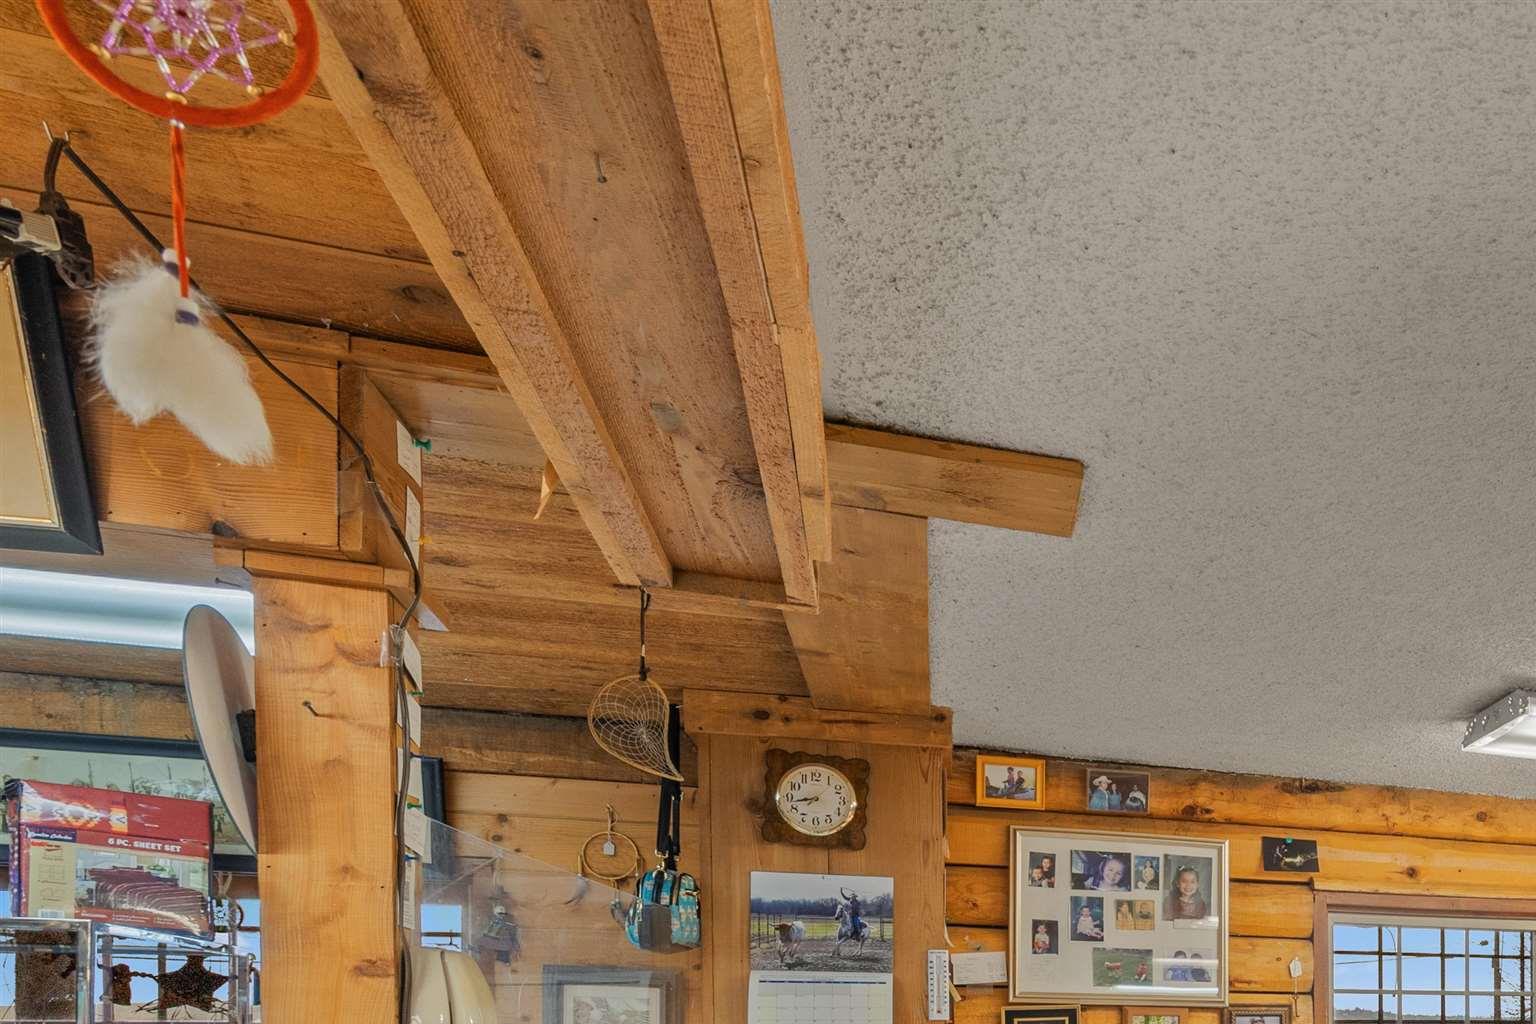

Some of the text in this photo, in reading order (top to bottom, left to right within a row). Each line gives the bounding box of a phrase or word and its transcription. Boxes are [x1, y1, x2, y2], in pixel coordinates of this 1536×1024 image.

[801, 773, 807, 784] 11
[810, 771, 821, 782] 12
[790, 781, 800, 791] 10
[790, 803, 799, 813] 8
[800, 812, 807, 823] 7
[812, 816, 820, 826] 6
[824, 814, 832, 824] 5
[108, 837, 114, 845] 6
[133, 840, 162, 850] SHEET
[164, 844, 182, 852] SET
